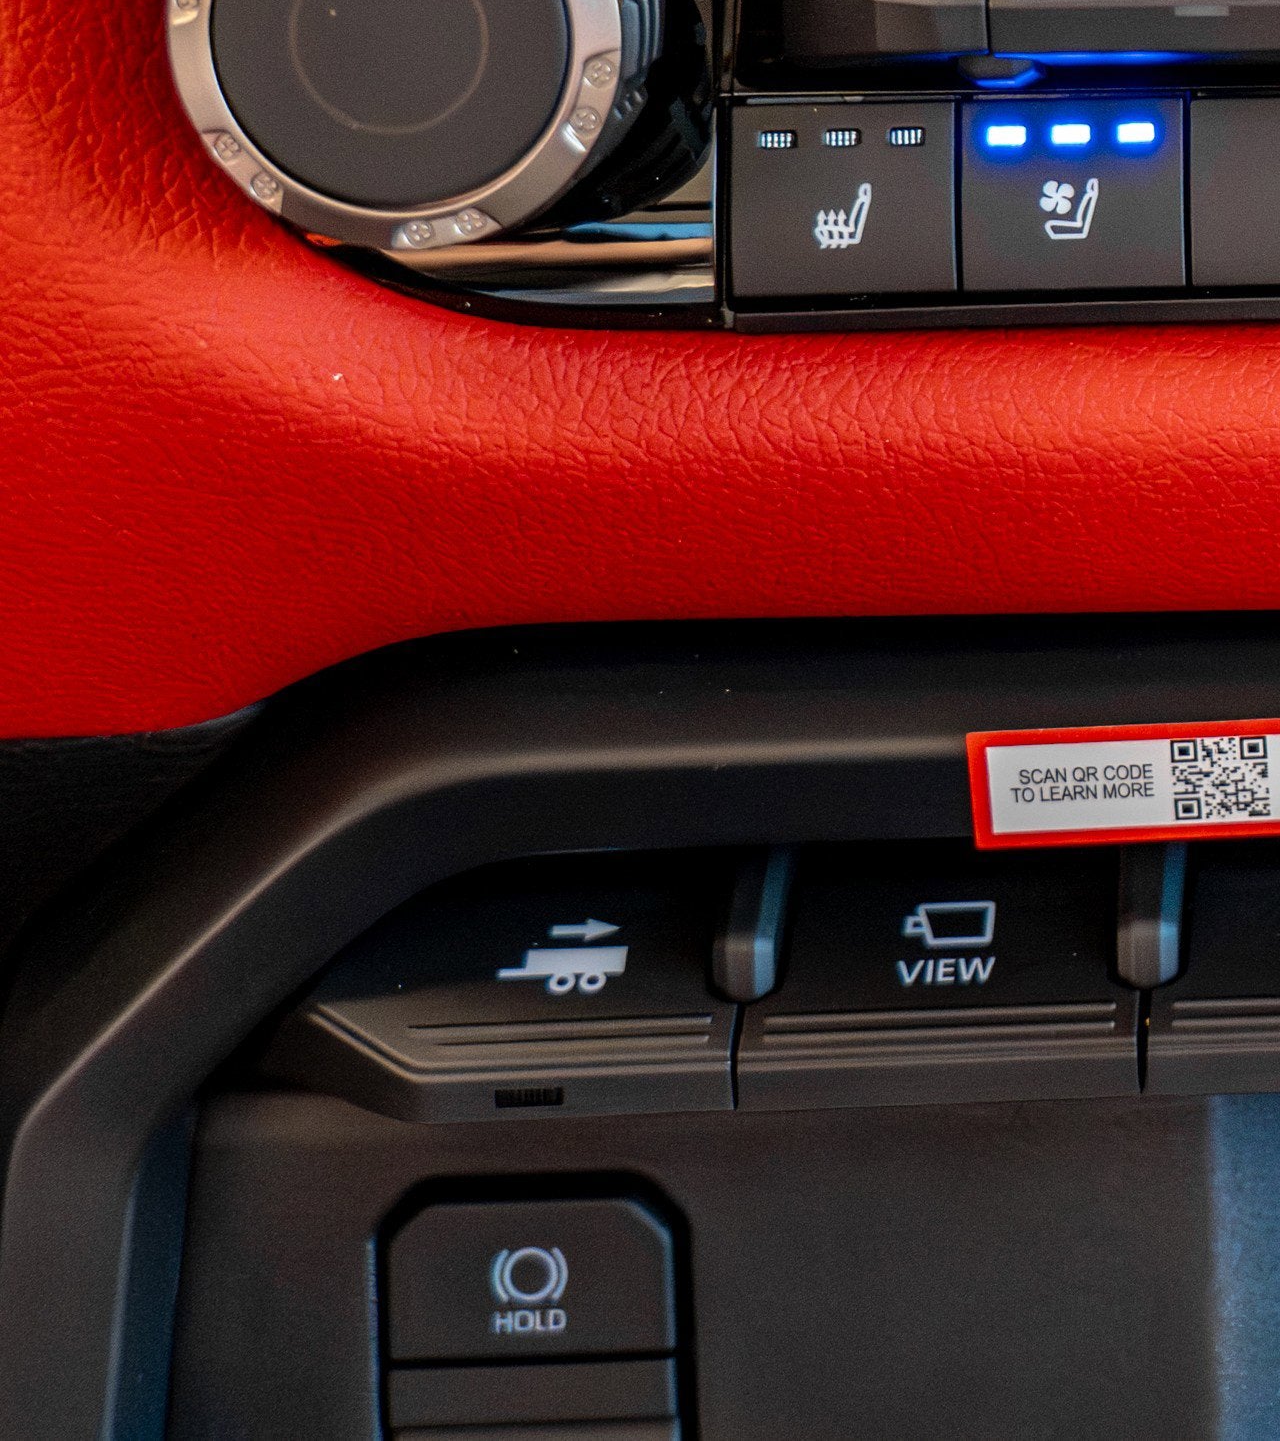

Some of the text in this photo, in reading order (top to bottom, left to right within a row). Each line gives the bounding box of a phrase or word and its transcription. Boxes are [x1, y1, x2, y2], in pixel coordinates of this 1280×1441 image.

[1019, 763, 1154, 785] SCAN QR CODE
[1011, 781, 1155, 803] TO LEARN MORE
[896, 955, 996, 986] VIEW
[493, 1309, 567, 1334] HOLD
